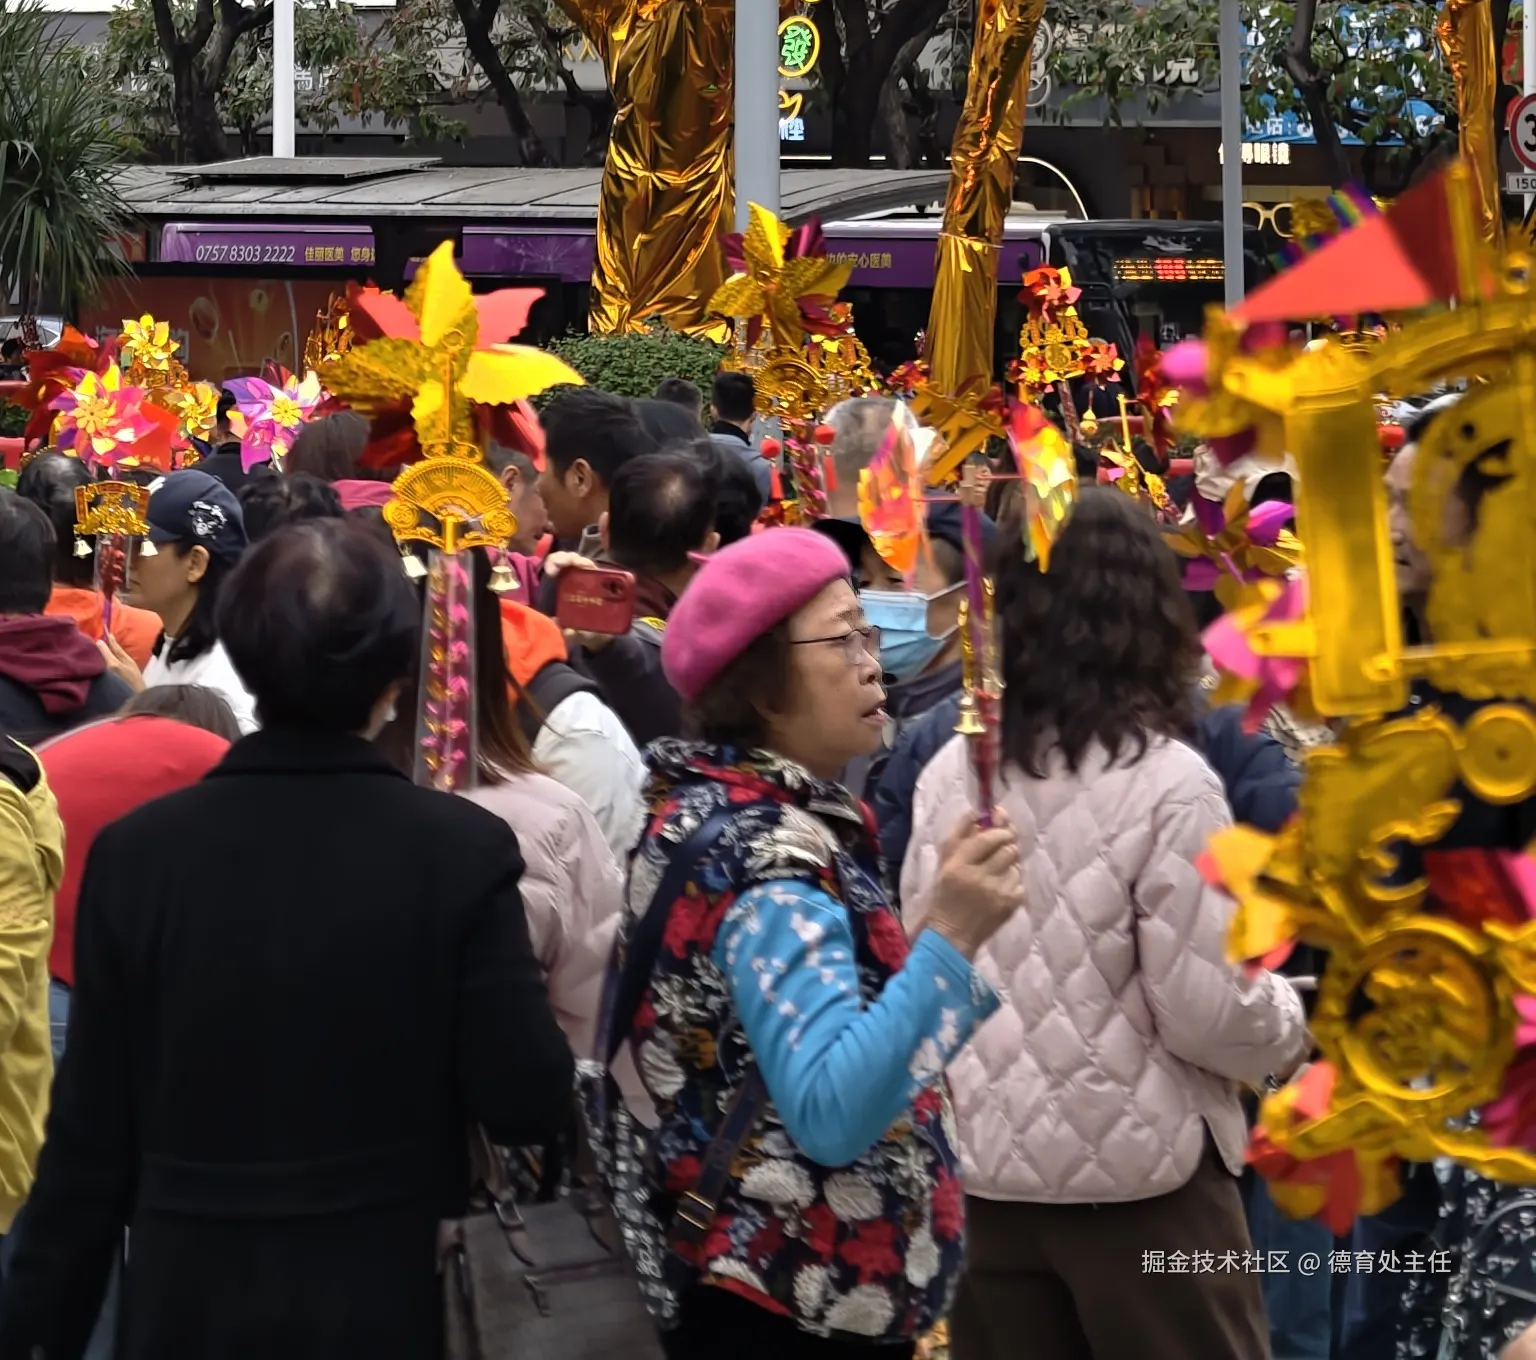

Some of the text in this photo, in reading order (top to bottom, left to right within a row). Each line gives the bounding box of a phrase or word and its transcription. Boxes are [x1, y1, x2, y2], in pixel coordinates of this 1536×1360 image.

[783, 25, 813, 71] 發
[195, 244, 296, 263] 0757 8303 2222
[305, 247, 344, 263] 佳丽医美
